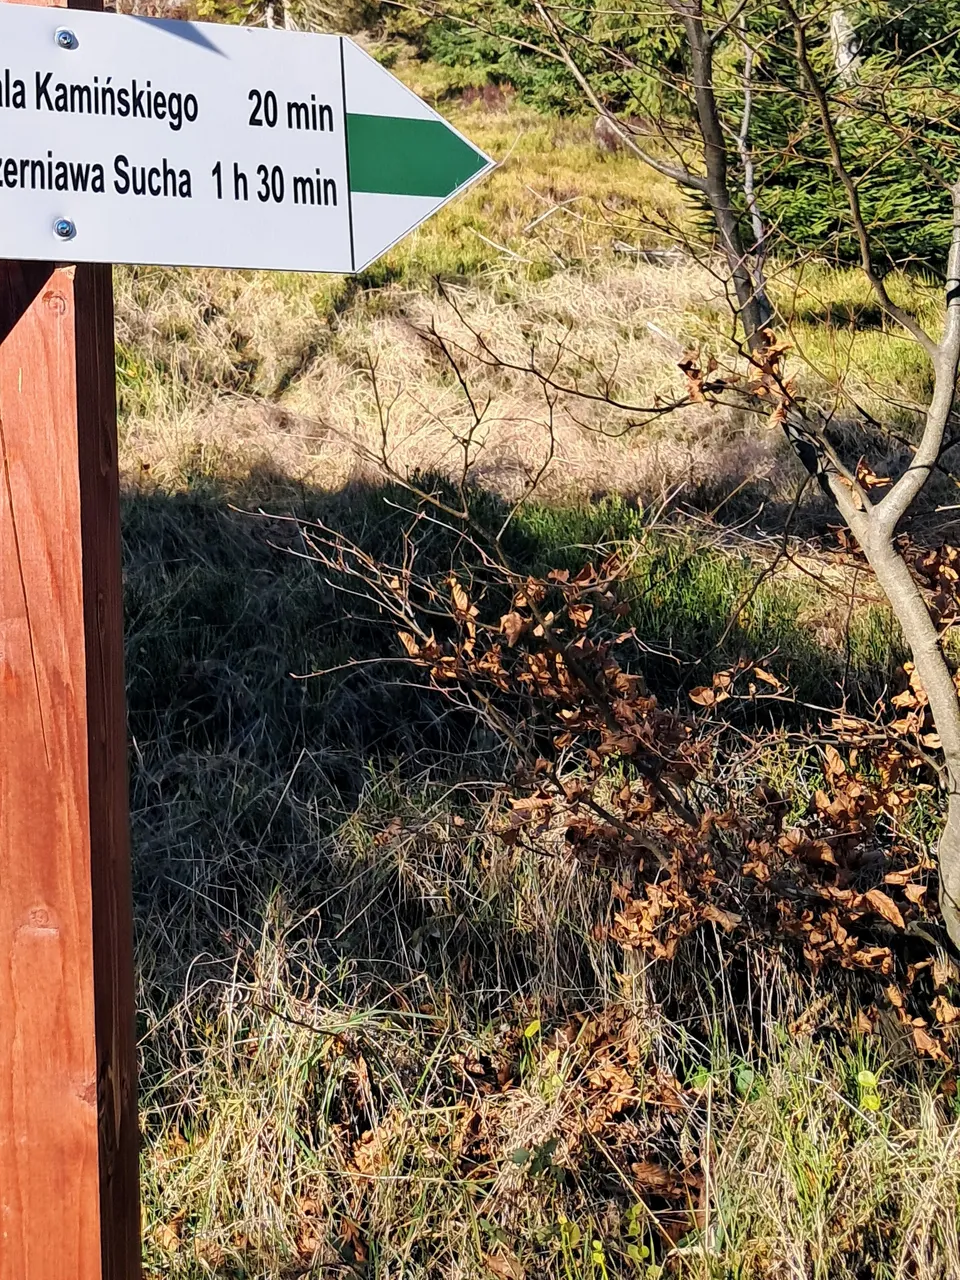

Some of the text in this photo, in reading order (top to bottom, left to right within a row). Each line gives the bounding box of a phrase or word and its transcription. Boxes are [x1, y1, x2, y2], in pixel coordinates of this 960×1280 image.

[35, 71, 199, 132] Kamińskiego
[248, 88, 278, 128] 20
[286, 93, 335, 133] min
[113, 154, 193, 200] Sucha
[211, 160, 223, 200] 1
[233, 162, 249, 201] h
[256, 164, 286, 204] 30
[292, 167, 339, 208] min
